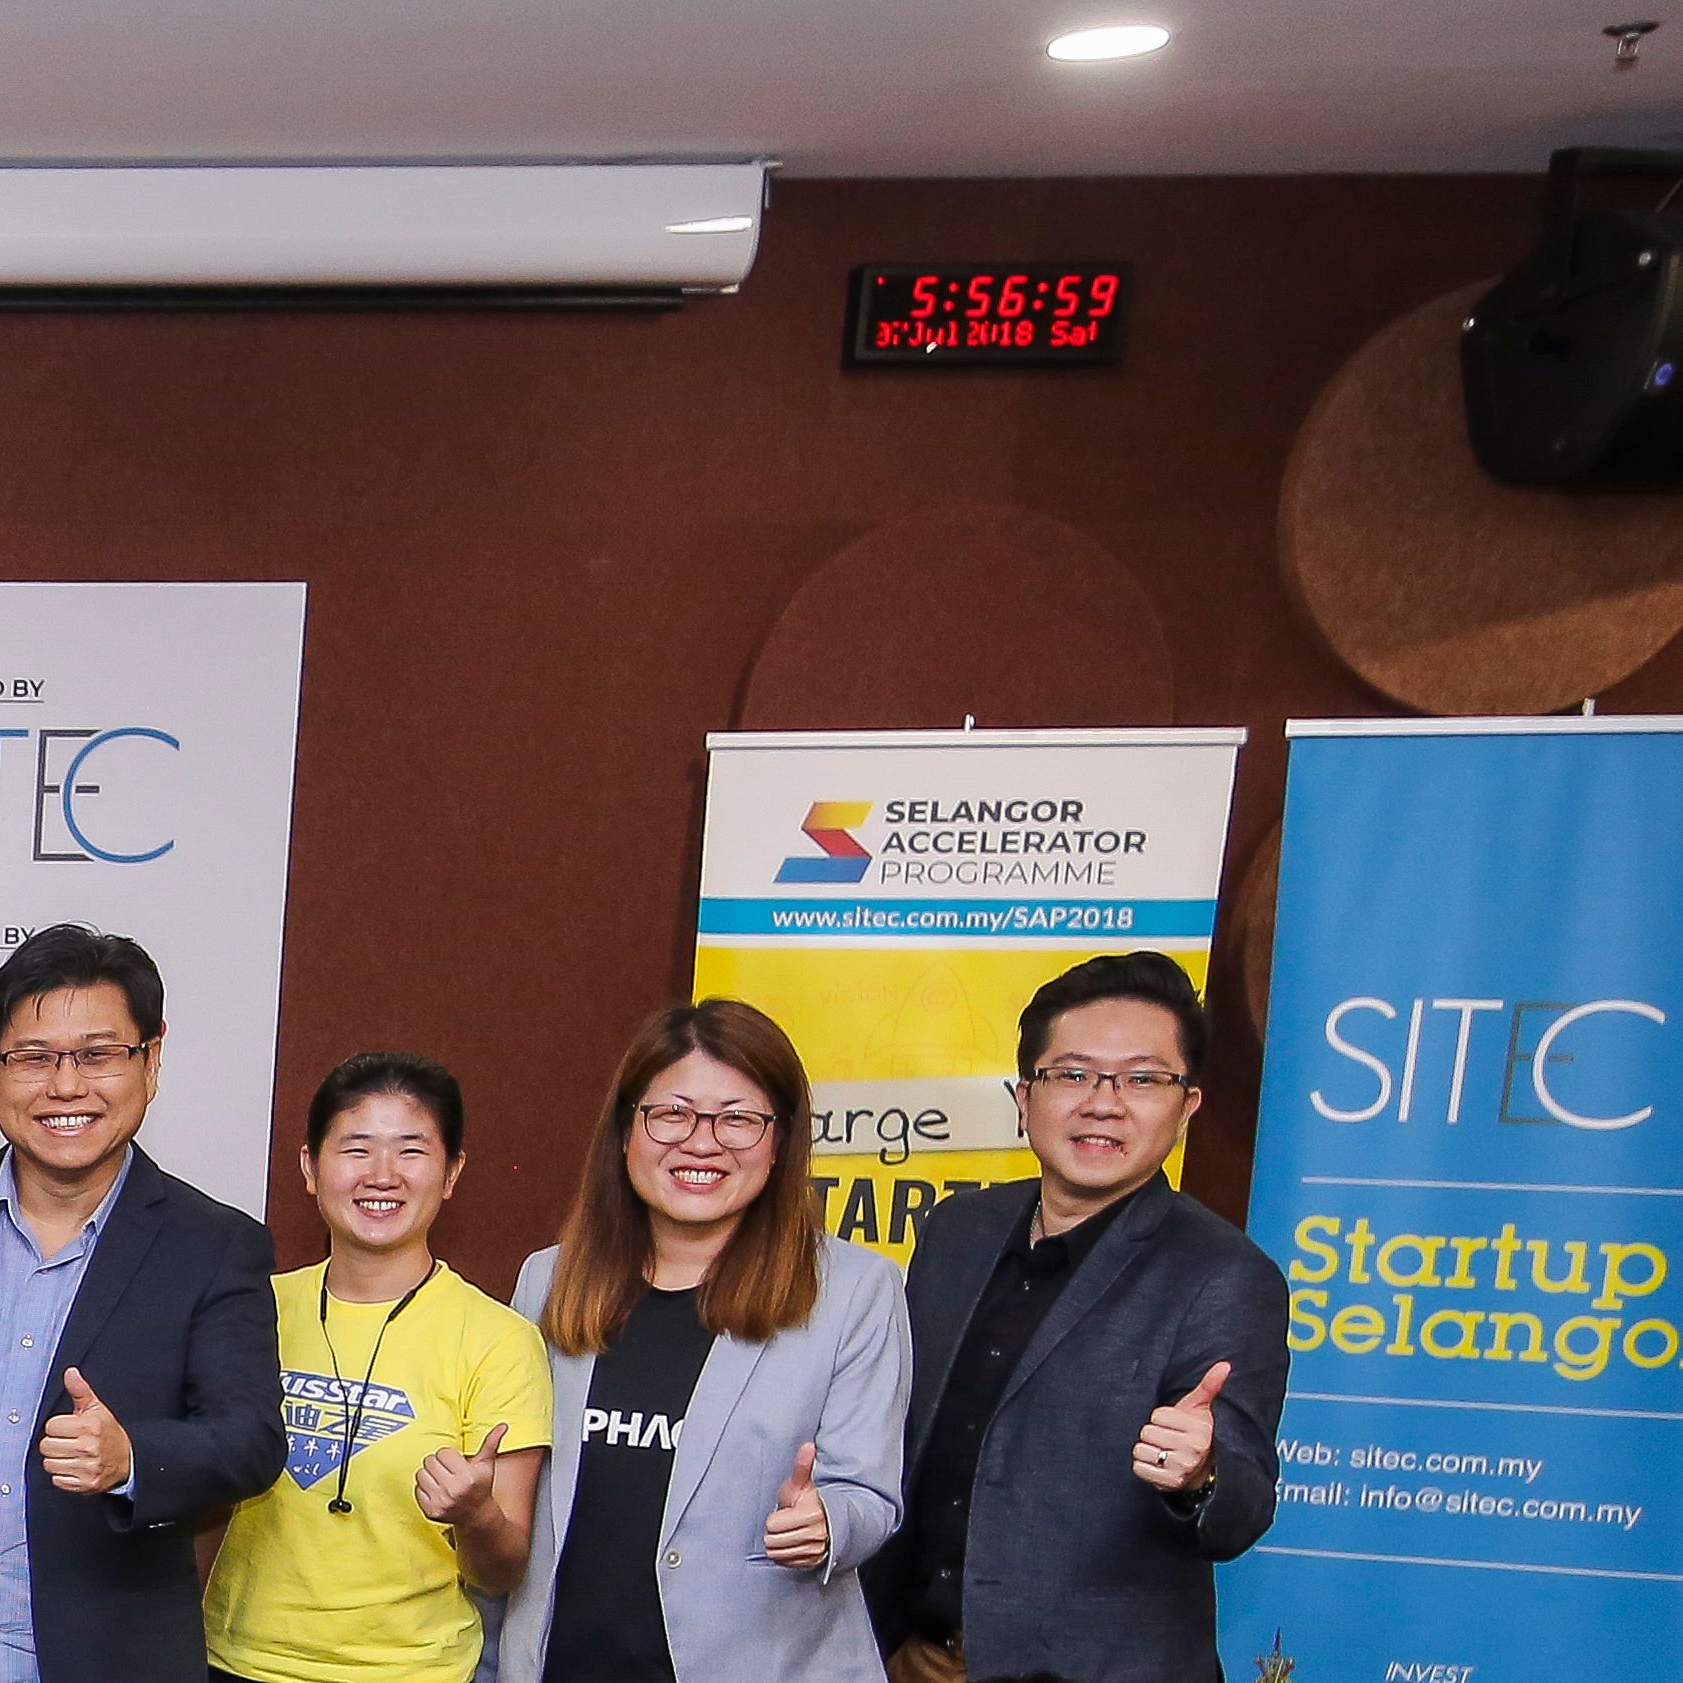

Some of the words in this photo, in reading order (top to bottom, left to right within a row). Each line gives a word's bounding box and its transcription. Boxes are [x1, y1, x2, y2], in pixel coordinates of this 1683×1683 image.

[910, 275, 1119, 318] 5:56:59
[12, 679, 45, 698] BY
[884, 800, 1085, 824] SELANGOR
[880, 830, 1147, 855] ACCELERATOR
[880, 861, 1117, 885] PROGRAMME
[772, 905, 1134, 932] www.sitec.com.my/SAP2018
[4, 926, 35, 946] BY
[1309, 996, 1667, 1131] SITEC
[1289, 1214, 1669, 1311] Startup
[1287, 1288, 1683, 1381] Selango
[1349, 1443, 1543, 1484] sitec.com.my
[1360, 1483, 1643, 1531] info@sitec.com.my
